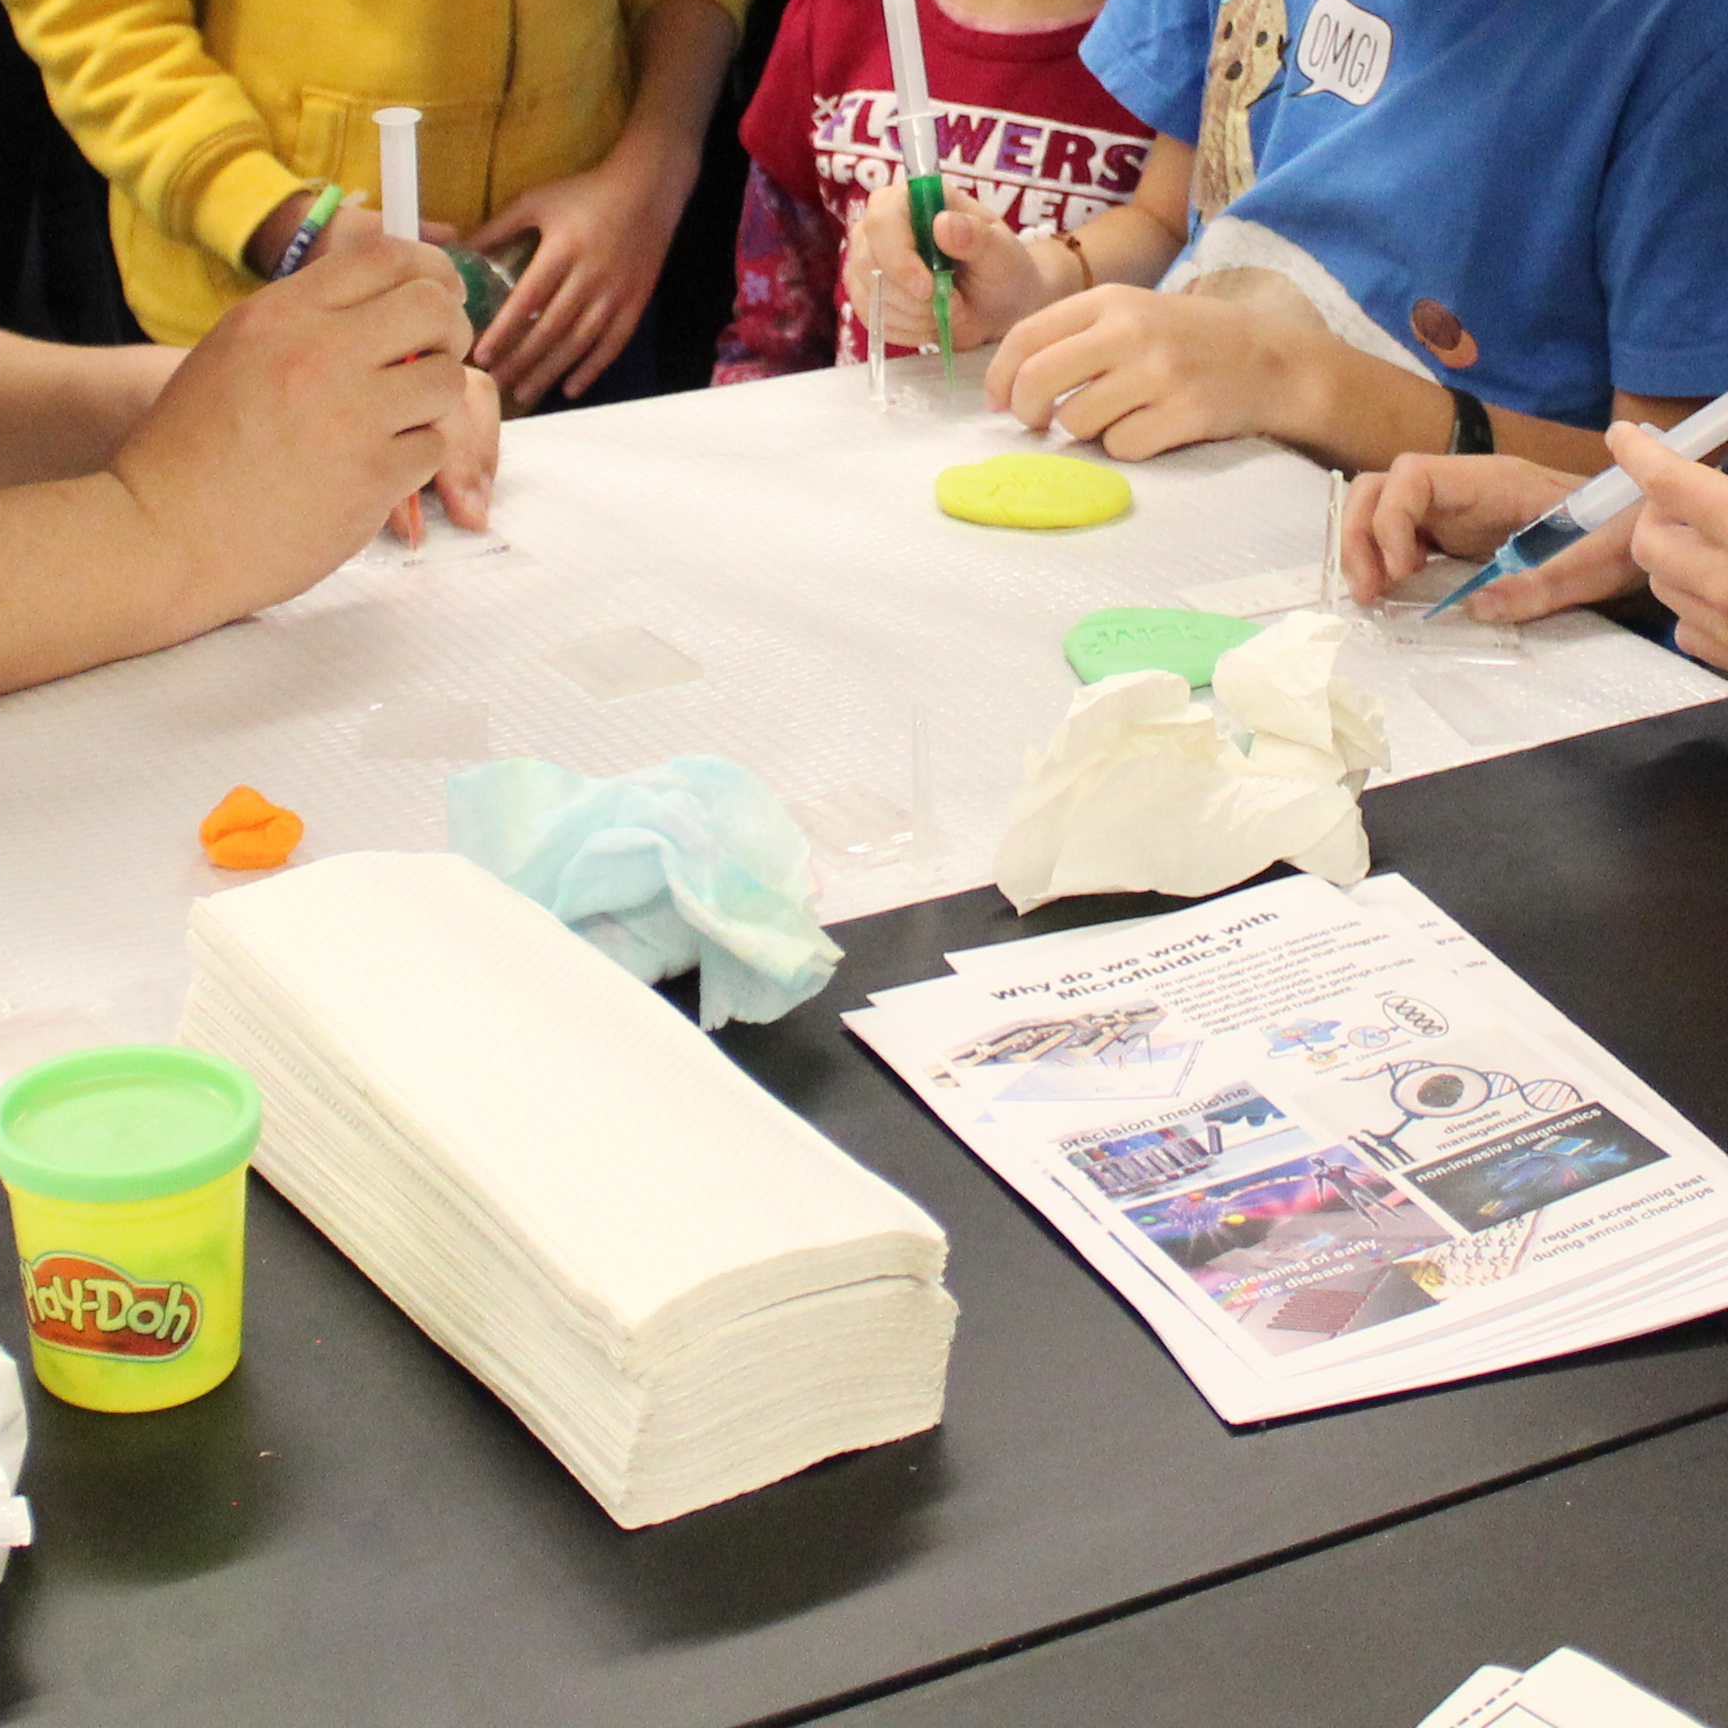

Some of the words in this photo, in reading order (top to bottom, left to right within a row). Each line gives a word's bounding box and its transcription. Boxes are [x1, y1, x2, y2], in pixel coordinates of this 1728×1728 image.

[1309, 13, 1377, 94] OMG!
[819, 96, 1150, 194] FLWERS
[991, 981, 1051, 1001] Why
[1059, 971, 1092, 985] do
[1100, 957, 1140, 972] we
[1148, 933, 1215, 959] work
[1220, 912, 1280, 935] with
[1056, 937, 1243, 1000] Microfluidics?
[1059, 1119, 1155, 1152] precision
[1159, 1087, 1250, 1123] medicine
[1415, 1140, 1512, 1184] non-invasive
[1513, 1107, 1603, 1147] diagnostics
[1436, 1110, 1534, 1152] management
[1444, 1108, 1501, 1135] disease
[1532, 1238, 1585, 1263] during
[1587, 1215, 1640, 1243] annual
[1640, 1185, 1715, 1221] checkups
[1541, 1217, 1595, 1245] regular
[1598, 1186, 1675, 1222] screening
[1674, 1173, 1708, 1191] test
[21, 1258, 192, 1345] Play-Doh
[1218, 1260, 1310, 1293] screening
[1311, 1251, 1331, 1265] of
[1333, 1238, 1378, 1259] early
[1230, 1283, 1283, 1306] stage
[1284, 1262, 1355, 1289] disease
